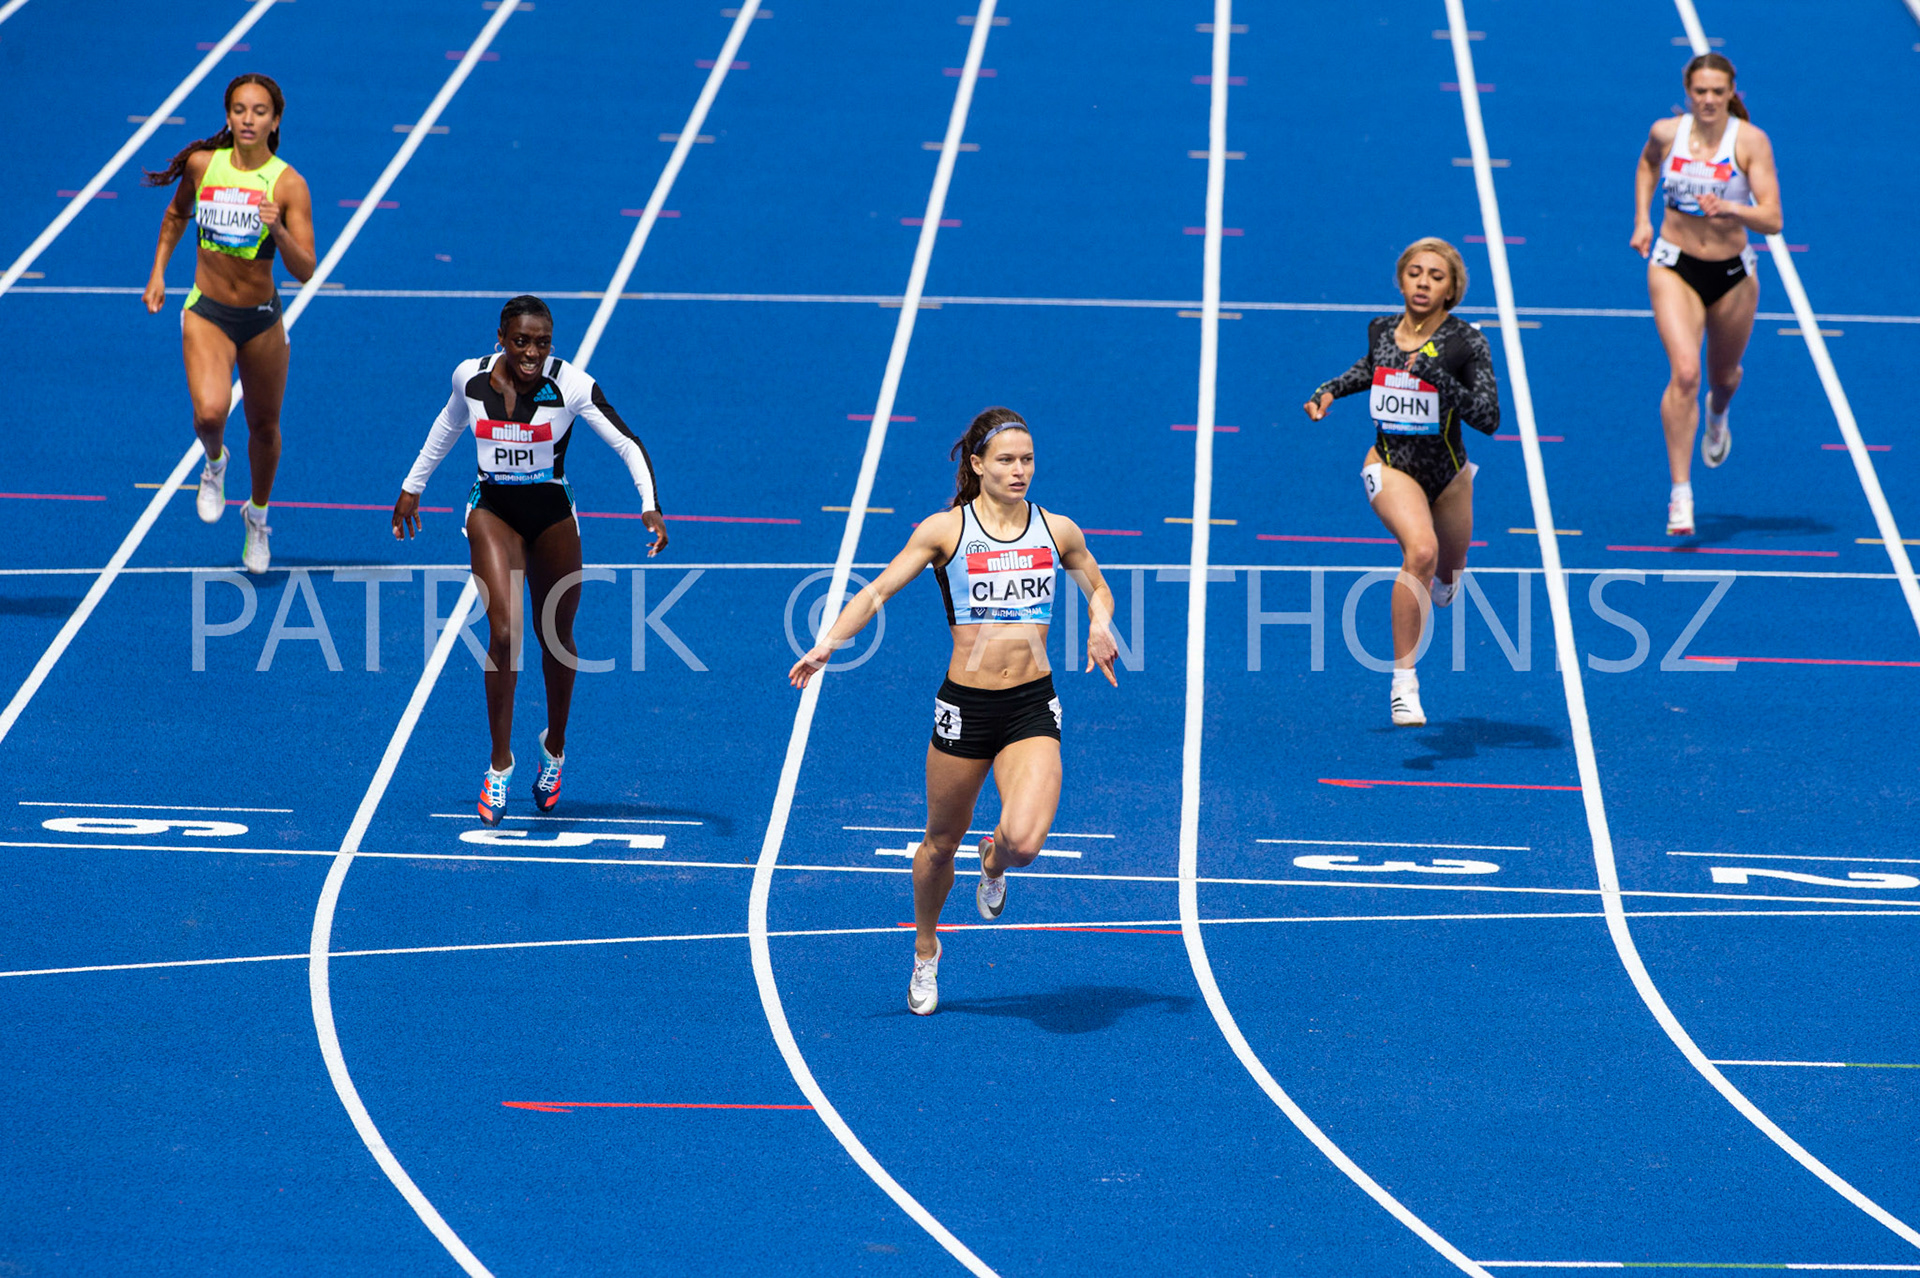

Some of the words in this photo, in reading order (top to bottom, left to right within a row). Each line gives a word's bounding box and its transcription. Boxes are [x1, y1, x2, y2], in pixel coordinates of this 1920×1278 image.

[199, 208, 261, 231] WILLIAMS
[1384, 371, 1421, 391] müller
[1375, 394, 1429, 416] JOHN
[491, 423, 535, 442] müller
[494, 447, 534, 467] PIPI
[494, 472, 545, 482] BIRMINGHAM
[1365, 473, 1376, 493] 3
[986, 550, 1034, 572] müller
[971, 576, 1052, 602] CLARK
[991, 607, 1043, 617] BIRMINGHAM
[938, 709, 953, 734] 4
[459, 829, 666, 849] 5
[1293, 855, 1500, 875] 3
[1710, 867, 1920, 889] 2
